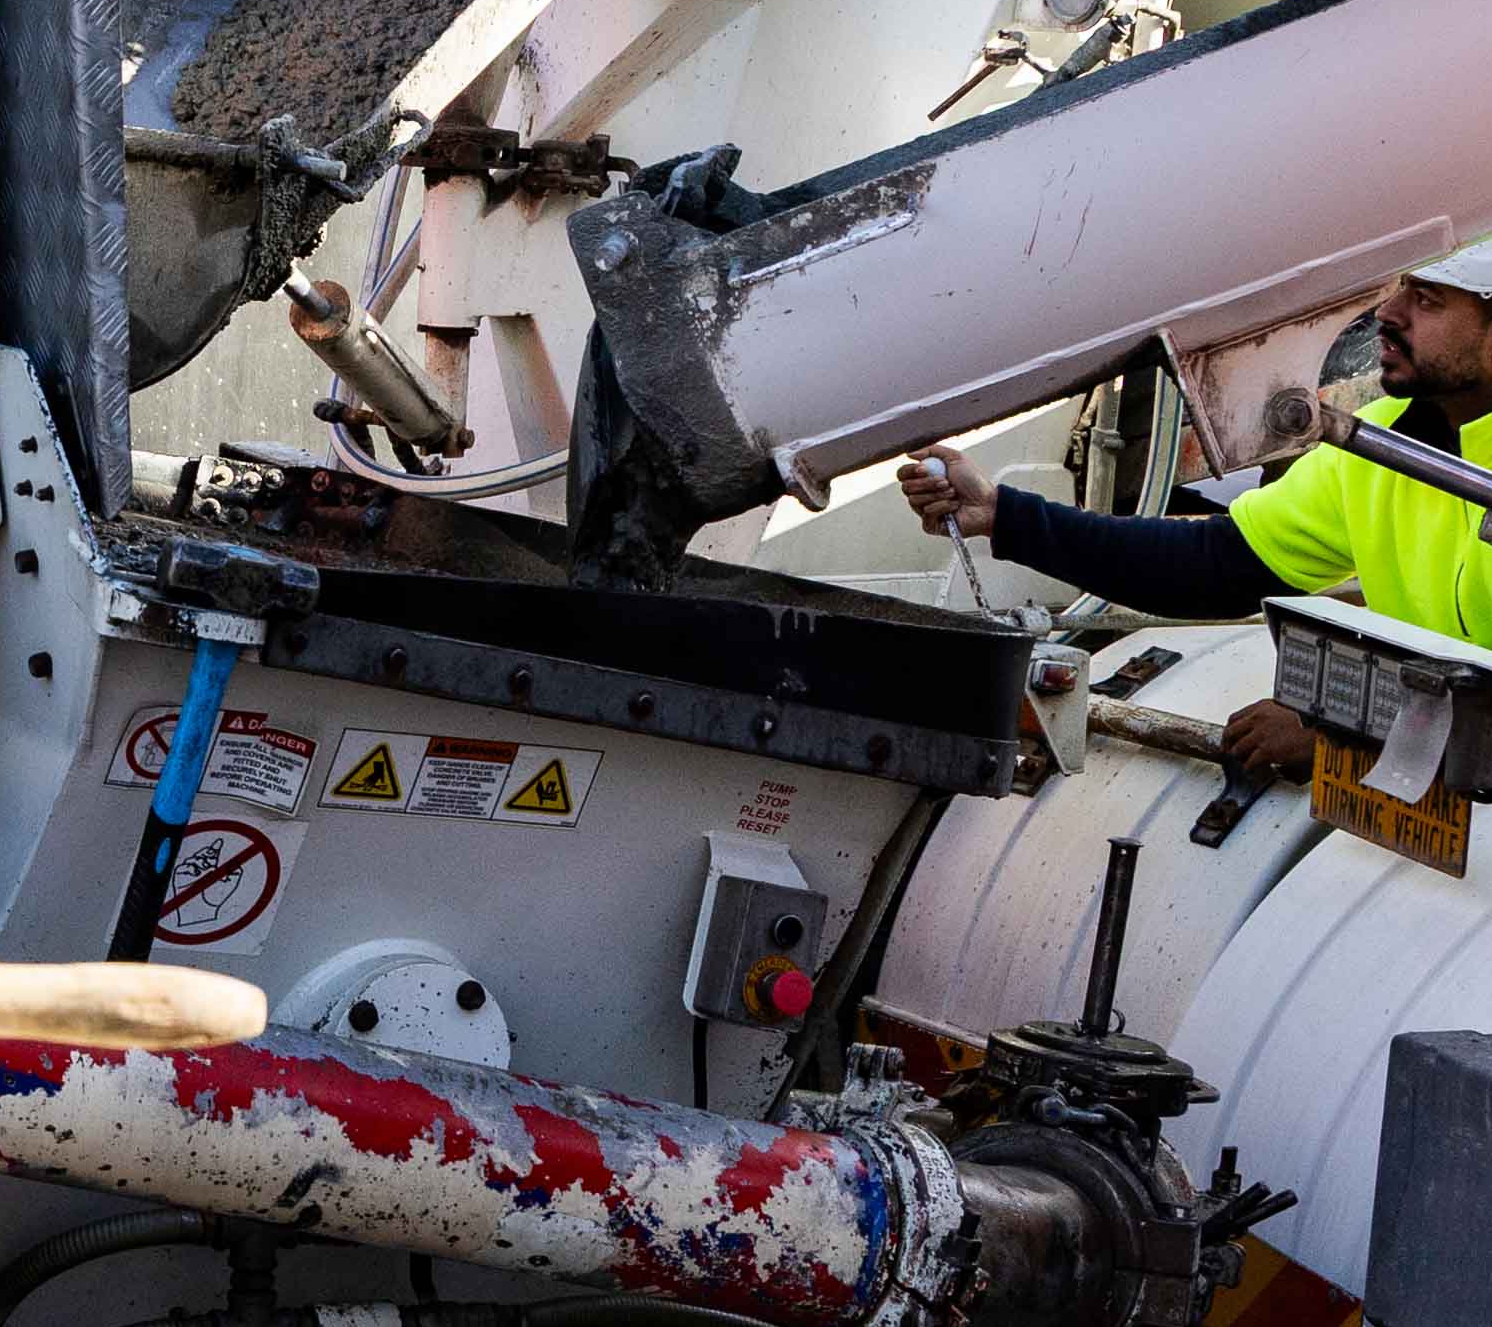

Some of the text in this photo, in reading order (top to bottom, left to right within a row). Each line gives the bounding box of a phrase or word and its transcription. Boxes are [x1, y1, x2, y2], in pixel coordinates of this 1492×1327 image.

[1323, 743, 1342, 779] DO
[760, 780, 798, 796] PUMP
[755, 793, 790, 809] STOP
[740, 804, 790, 824] PLEASE
[1322, 780, 1460, 863] TURNING VEHICLE
[737, 818, 781, 836] RESET
